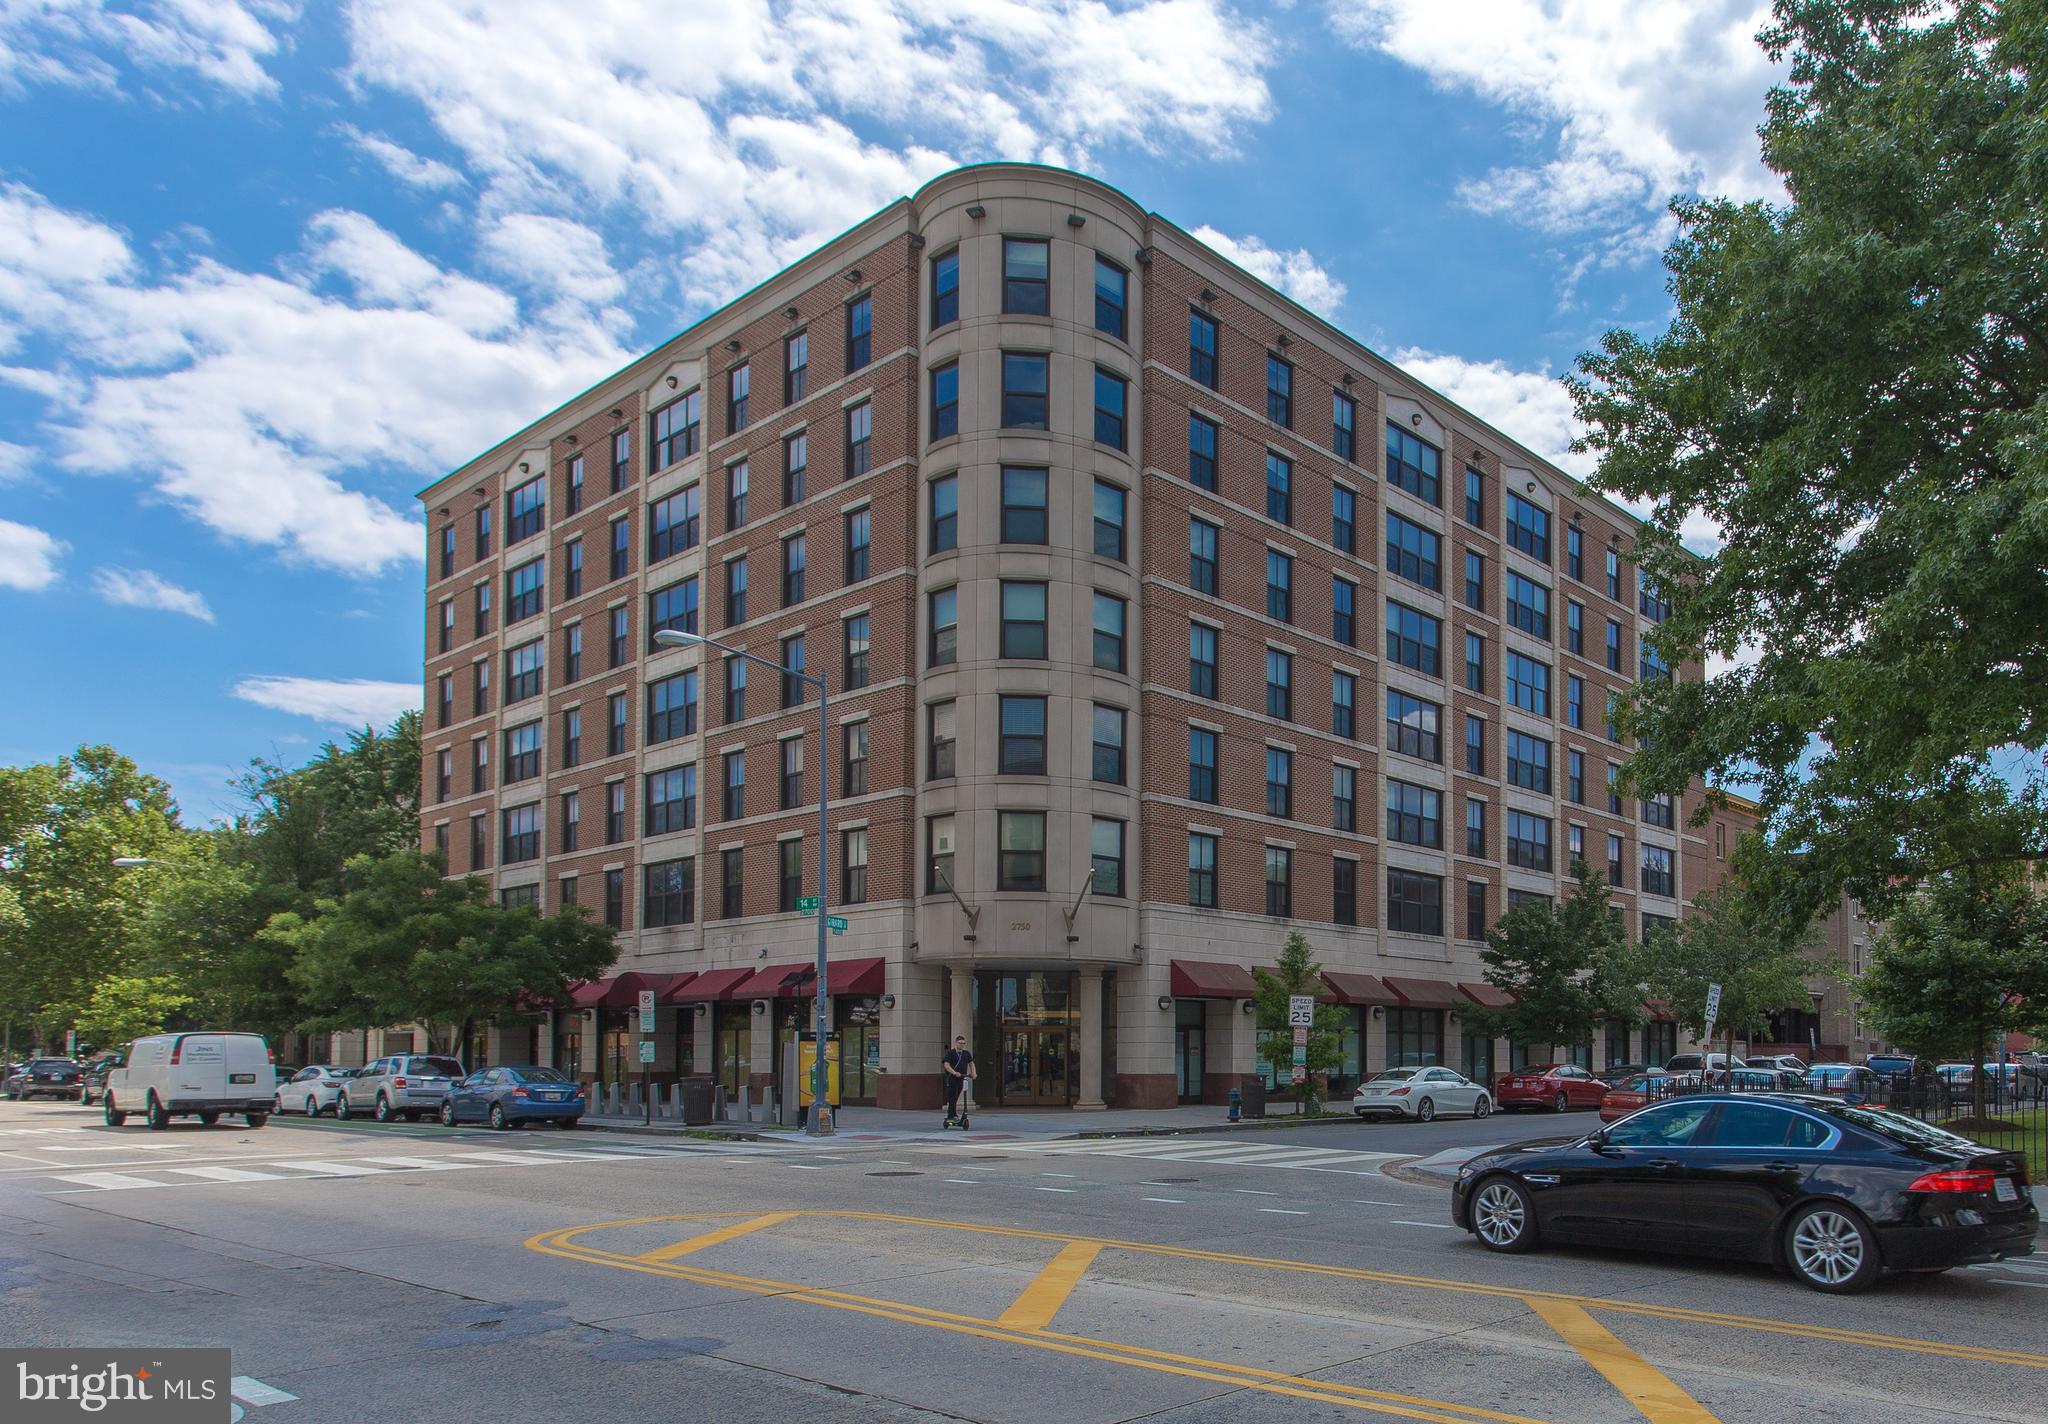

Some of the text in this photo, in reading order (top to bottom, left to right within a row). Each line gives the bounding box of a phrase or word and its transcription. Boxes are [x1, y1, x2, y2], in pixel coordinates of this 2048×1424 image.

[800, 900, 808, 908] 14
[1706, 1003, 1716, 1017] 25
[1292, 1012, 1310, 1022] 25
